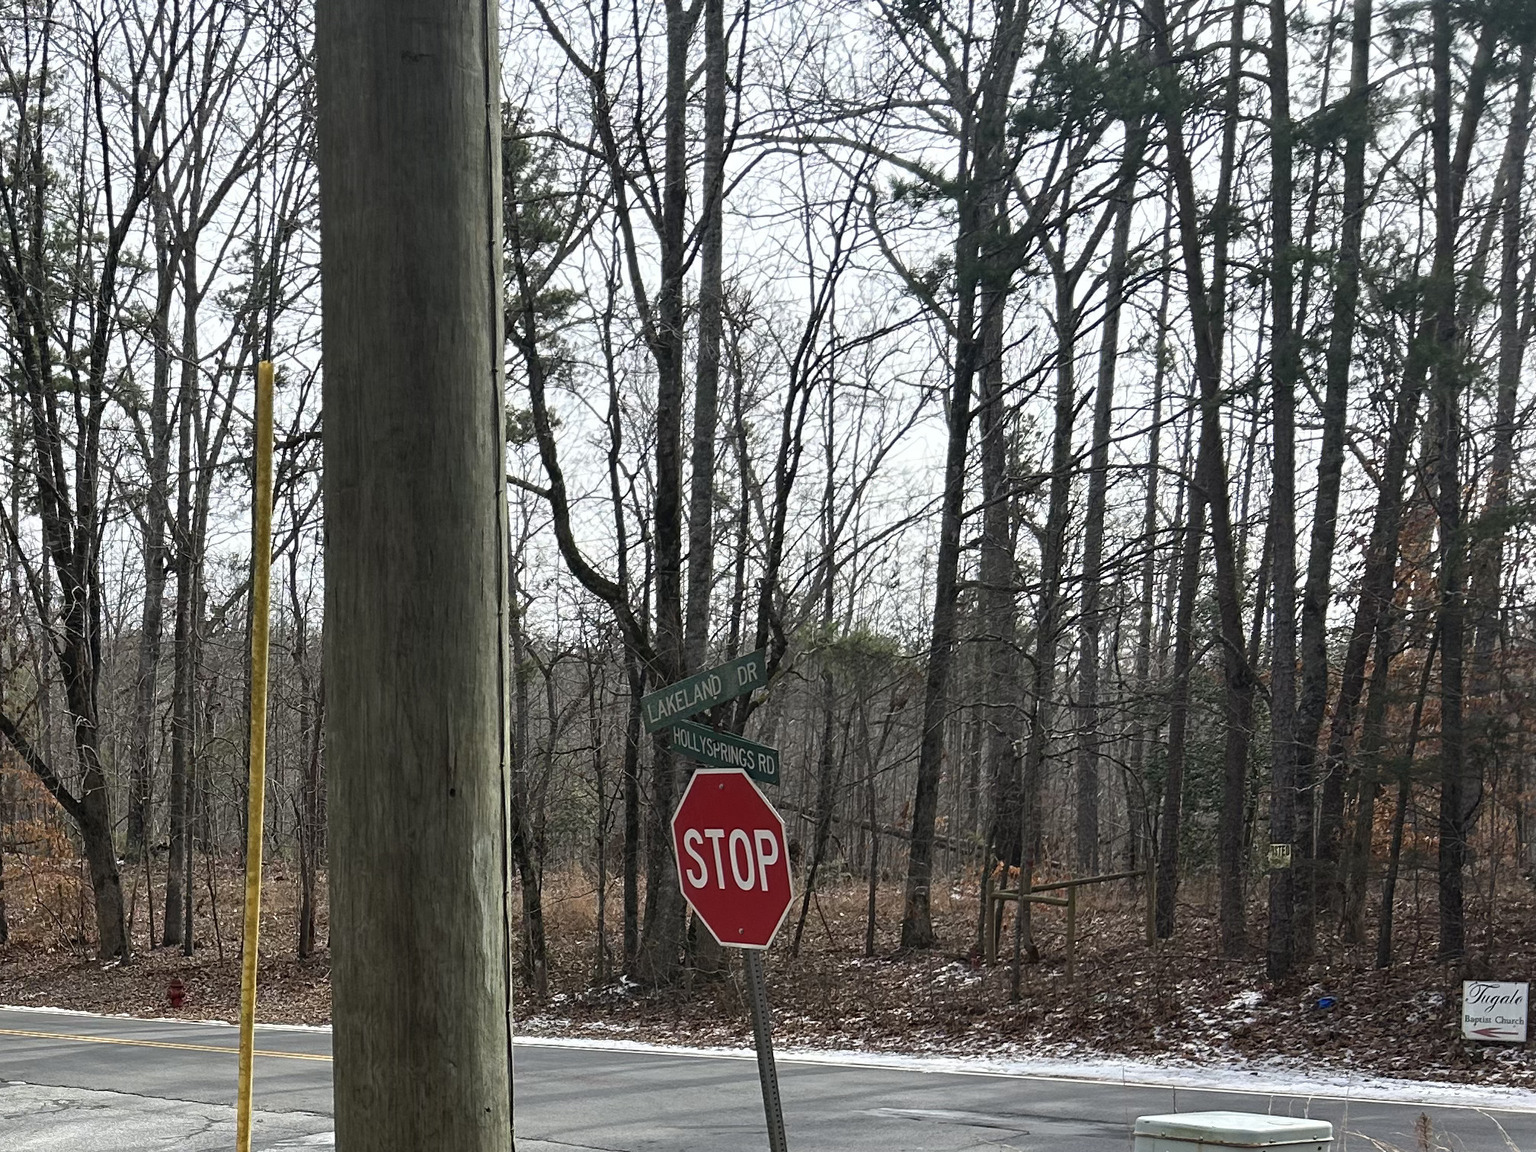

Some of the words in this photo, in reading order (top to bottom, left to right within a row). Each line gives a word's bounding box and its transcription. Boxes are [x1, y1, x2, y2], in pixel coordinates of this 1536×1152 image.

[646, 674, 722, 724] LAKELAND
[737, 661, 758, 687] DR
[672, 726, 755, 771] HOLLYSPRINGS
[758, 755, 775, 776] RD
[683, 828, 779, 892] STOP
[1464, 1015, 1492, 1025] Baptist
[1495, 1015, 1525, 1025] Church
[1465, 983, 1524, 1013] Tugalo
